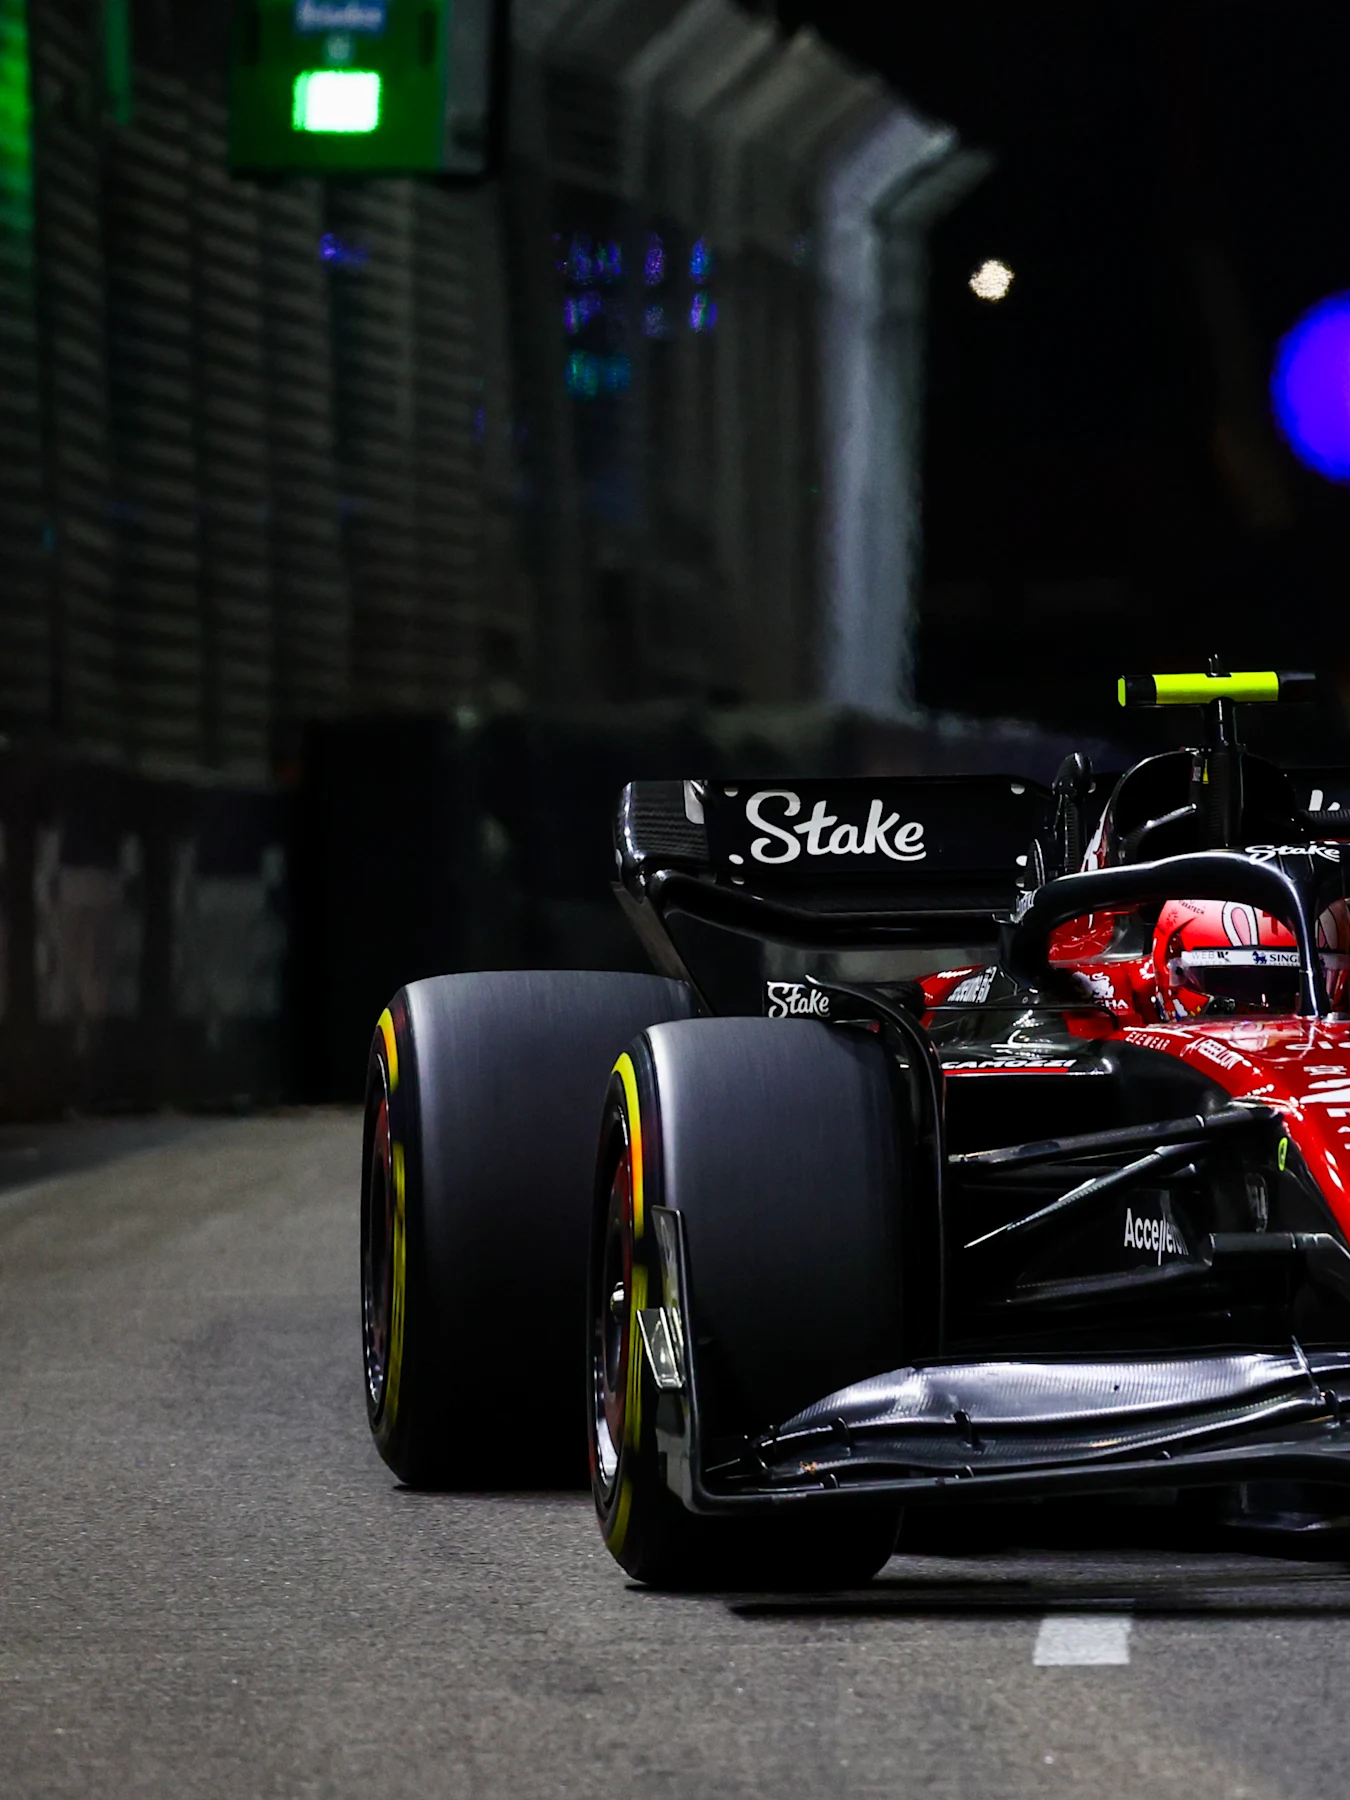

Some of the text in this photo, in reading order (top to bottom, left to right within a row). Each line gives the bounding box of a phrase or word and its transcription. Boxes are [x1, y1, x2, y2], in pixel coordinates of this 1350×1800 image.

[745, 789, 927, 864] Stake
[1245, 845, 1340, 865] Stake
[1269, 954, 1300, 964] SING
[767, 982, 831, 1018] Stake
[942, 1059, 1077, 1070] CAMOZZI
